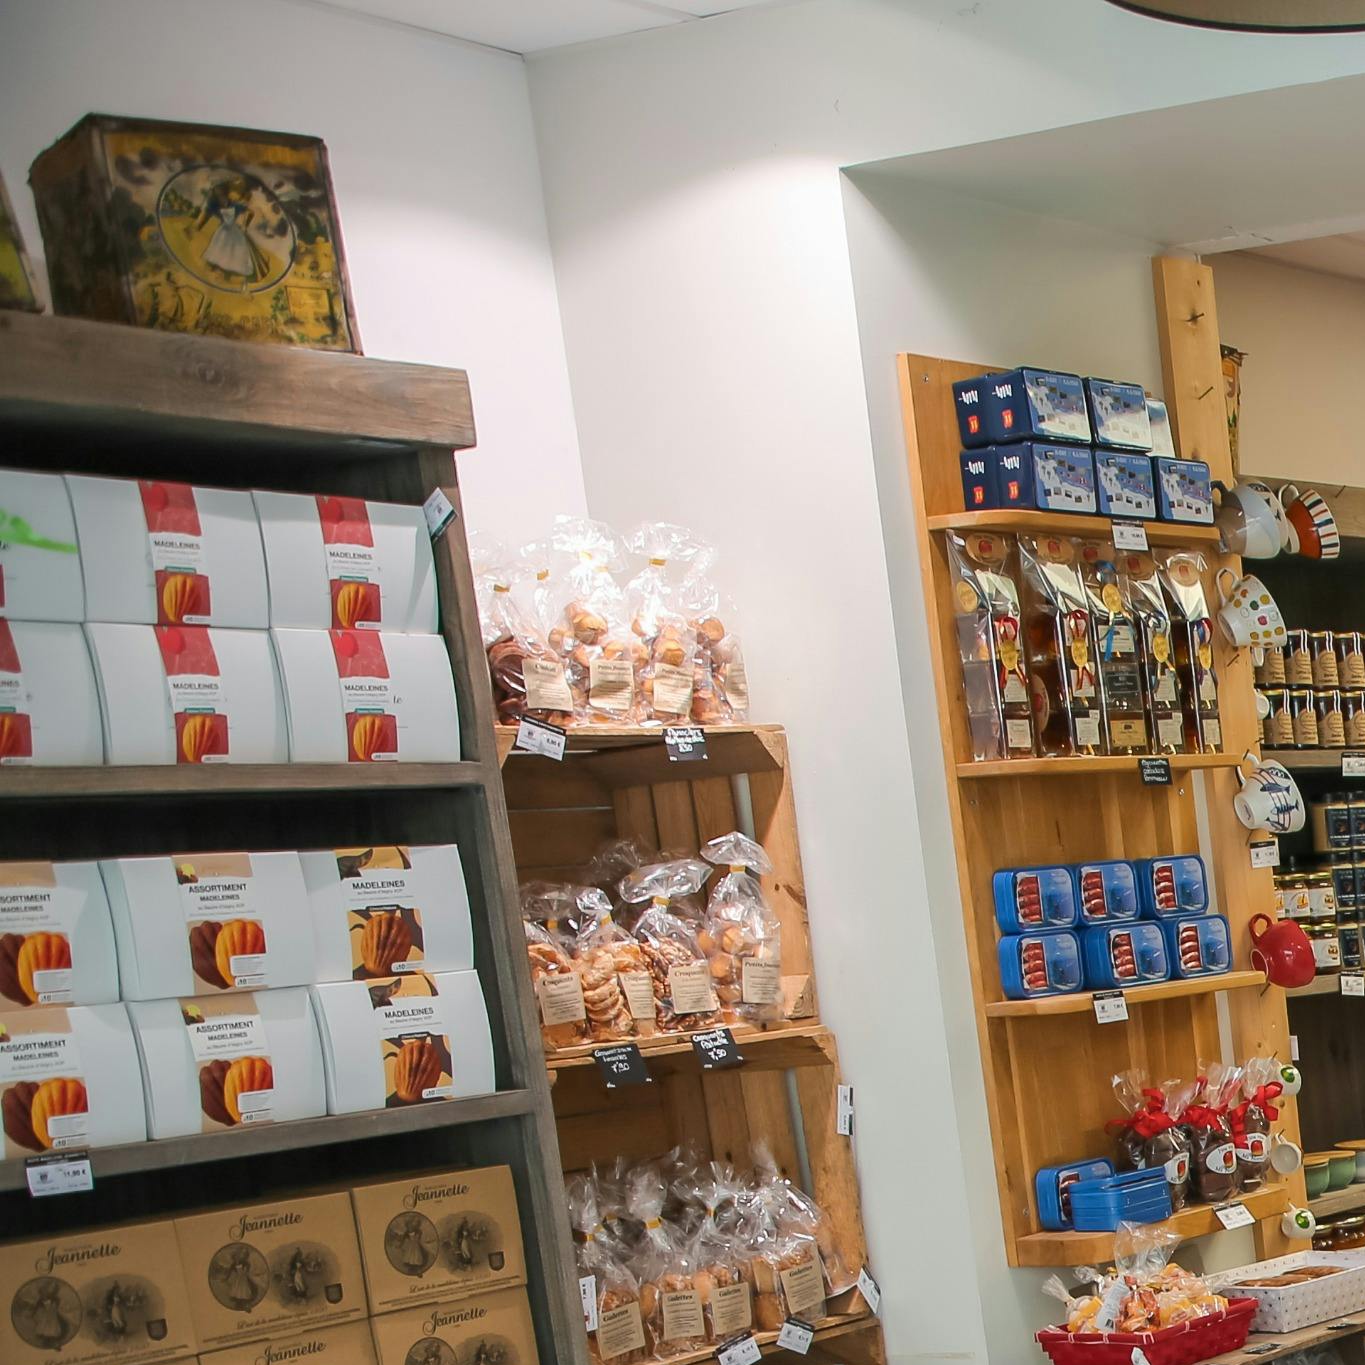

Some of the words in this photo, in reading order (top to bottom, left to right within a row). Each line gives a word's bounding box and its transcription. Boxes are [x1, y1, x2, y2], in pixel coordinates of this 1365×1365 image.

[154, 540, 200, 550] MADELEINES
[329, 552, 373, 561] MADELEINES
[188, 883, 247, 894] ASSORTIMENT
[352, 880, 405, 890] MADELEINES
[384, 1007, 434, 1019] MADELEINES
[196, 1021, 254, 1034] ASSORTIMENT
[207, 1032, 248, 1041] MADELEINES
[0, 1039, 66, 1053] ASSORTIMENT
[13, 1052, 59, 1062] MADELEINES
[403, 1184, 471, 1210] Jeannette
[229, 1212, 304, 1242] Jeannette
[35, 1243, 122, 1274] Jeannette
[422, 1307, 488, 1336] Jeannette
